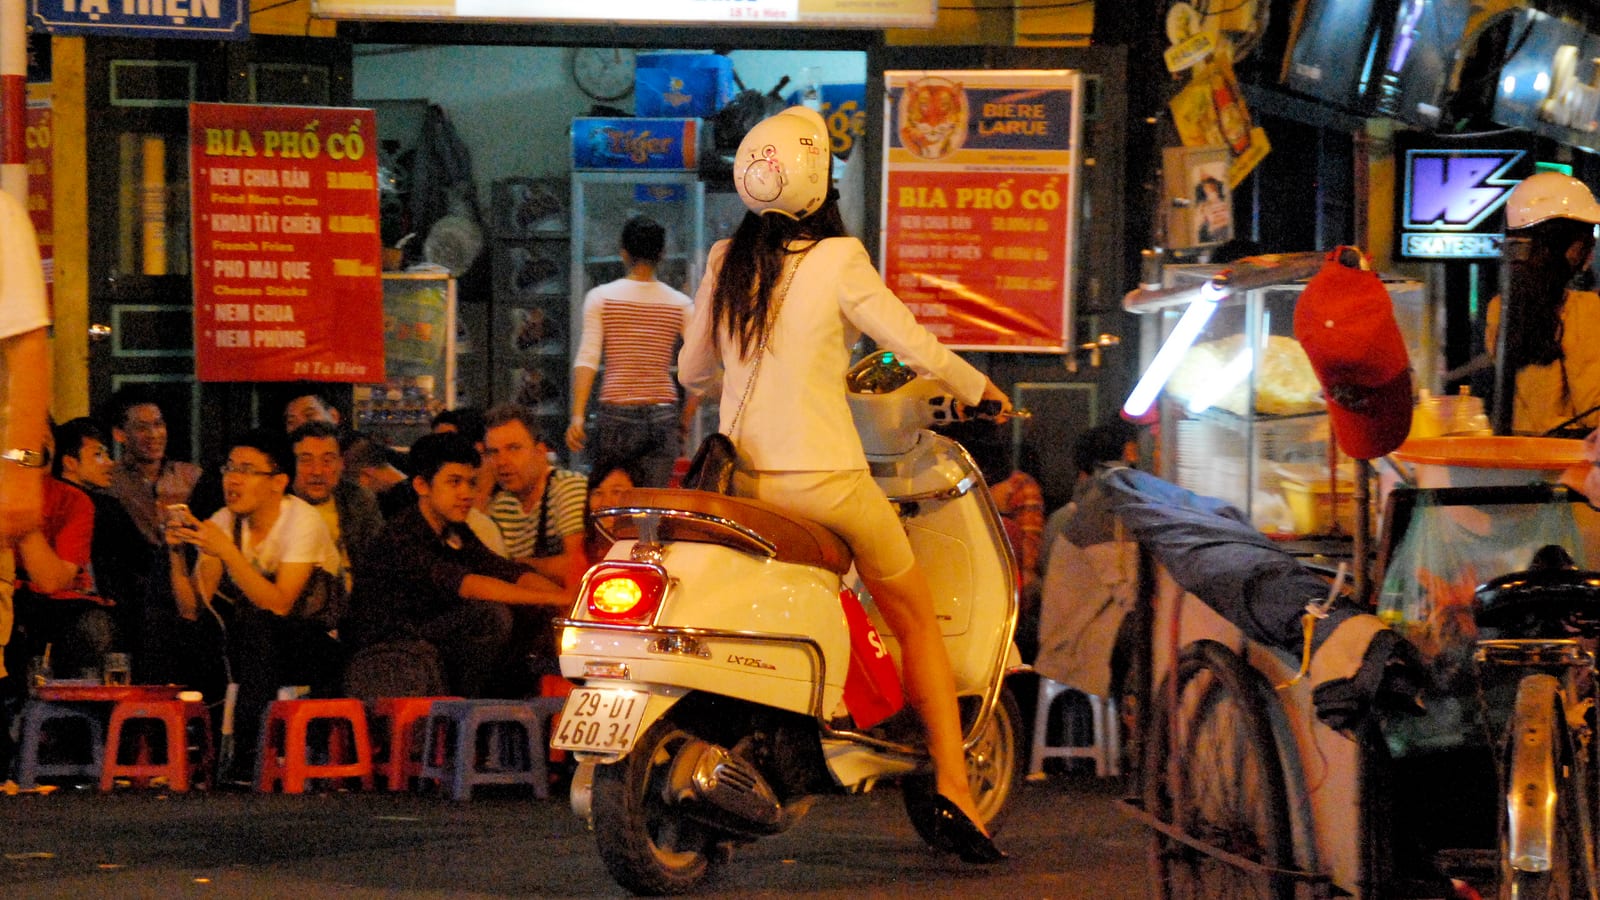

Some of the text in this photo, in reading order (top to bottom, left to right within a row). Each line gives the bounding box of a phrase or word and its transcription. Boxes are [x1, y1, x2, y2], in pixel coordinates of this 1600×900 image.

[205, 128, 257, 157] BIA
[263, 119, 321, 159] PHỐ
[978, 120, 1049, 136] LARUE
[899, 186, 949, 209] BIA
[956, 178, 1015, 210] PHỐ
[281, 261, 312, 281] QUE
[558, 720, 631, 748] 460.34
